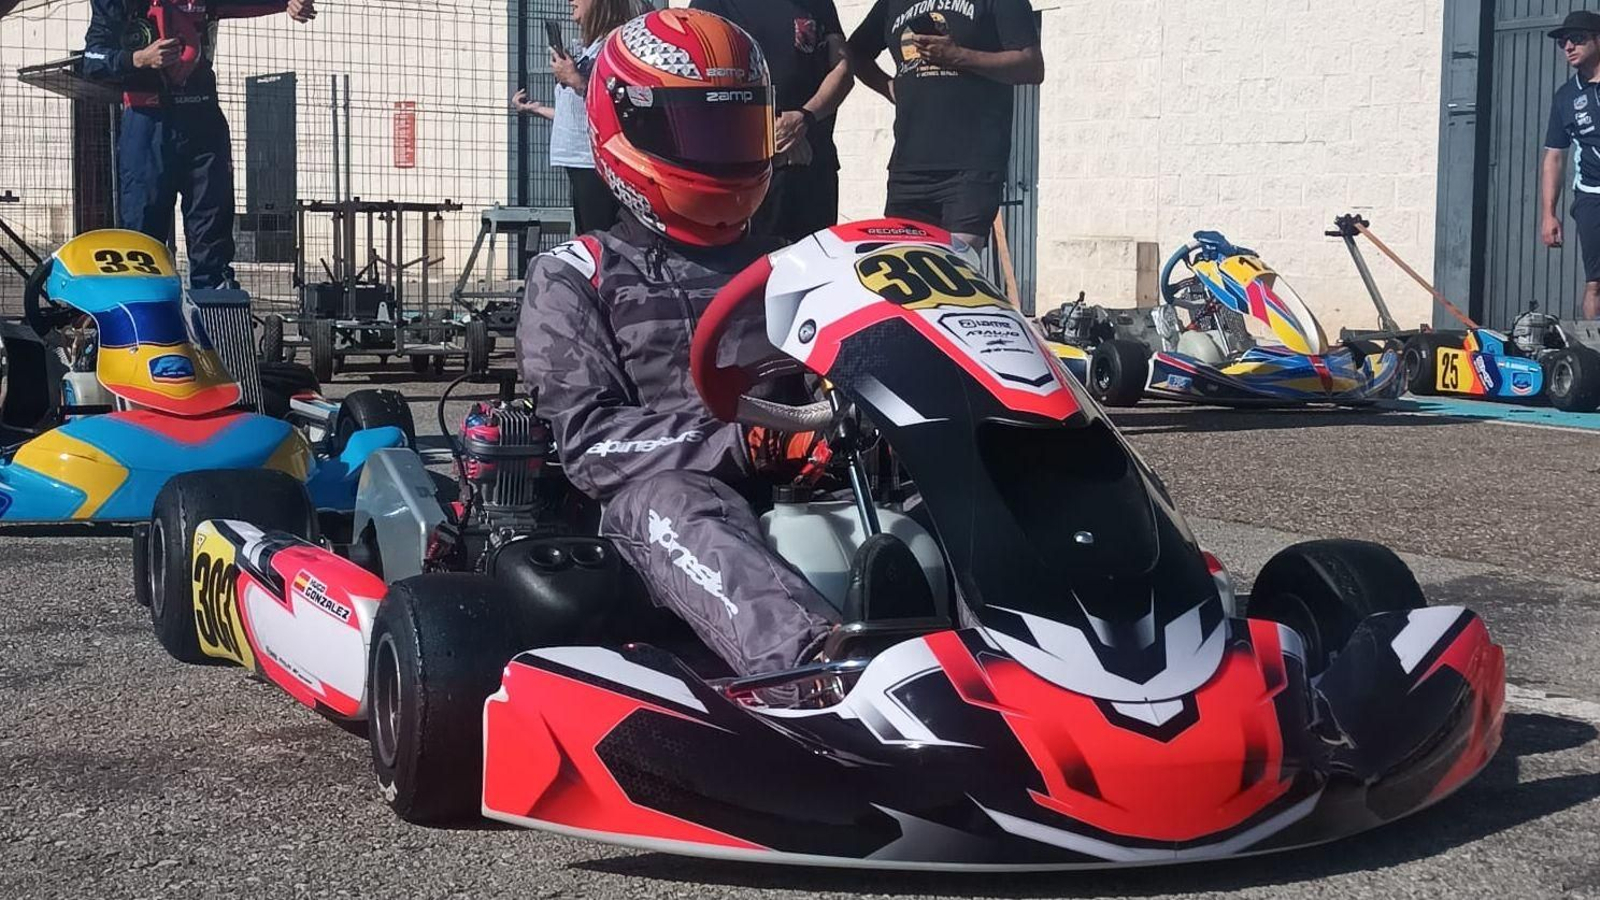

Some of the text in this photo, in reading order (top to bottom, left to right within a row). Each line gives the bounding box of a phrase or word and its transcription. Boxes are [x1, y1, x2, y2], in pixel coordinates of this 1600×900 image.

[937, 0, 975, 20] SENNA
[706, 91, 753, 103] zamp
[867, 228, 927, 236] REDSPEED
[94, 250, 163, 275] 33
[1441, 352, 1459, 390] 25
[305, 587, 350, 620] GONZALEZ
